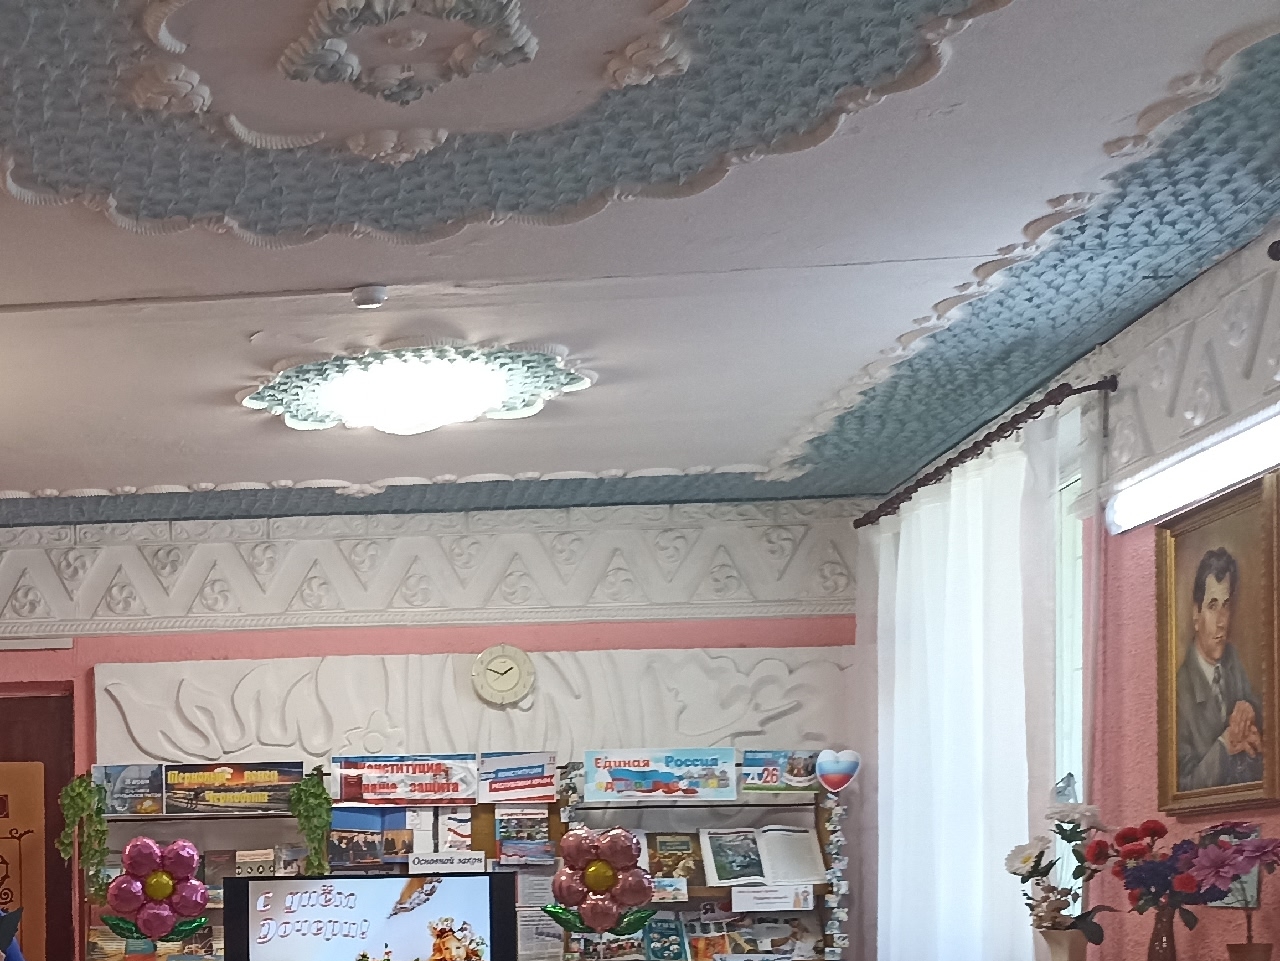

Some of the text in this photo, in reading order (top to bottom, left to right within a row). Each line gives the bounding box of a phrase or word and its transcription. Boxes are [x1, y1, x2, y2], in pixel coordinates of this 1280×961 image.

[594, 757, 650, 769] Единая
[664, 755, 719, 768] Россия
[409, 782, 459, 794] защита
[412, 856, 455, 866] Основной
[284, 884, 357, 914] днём
[256, 917, 370, 944] Дочери!
